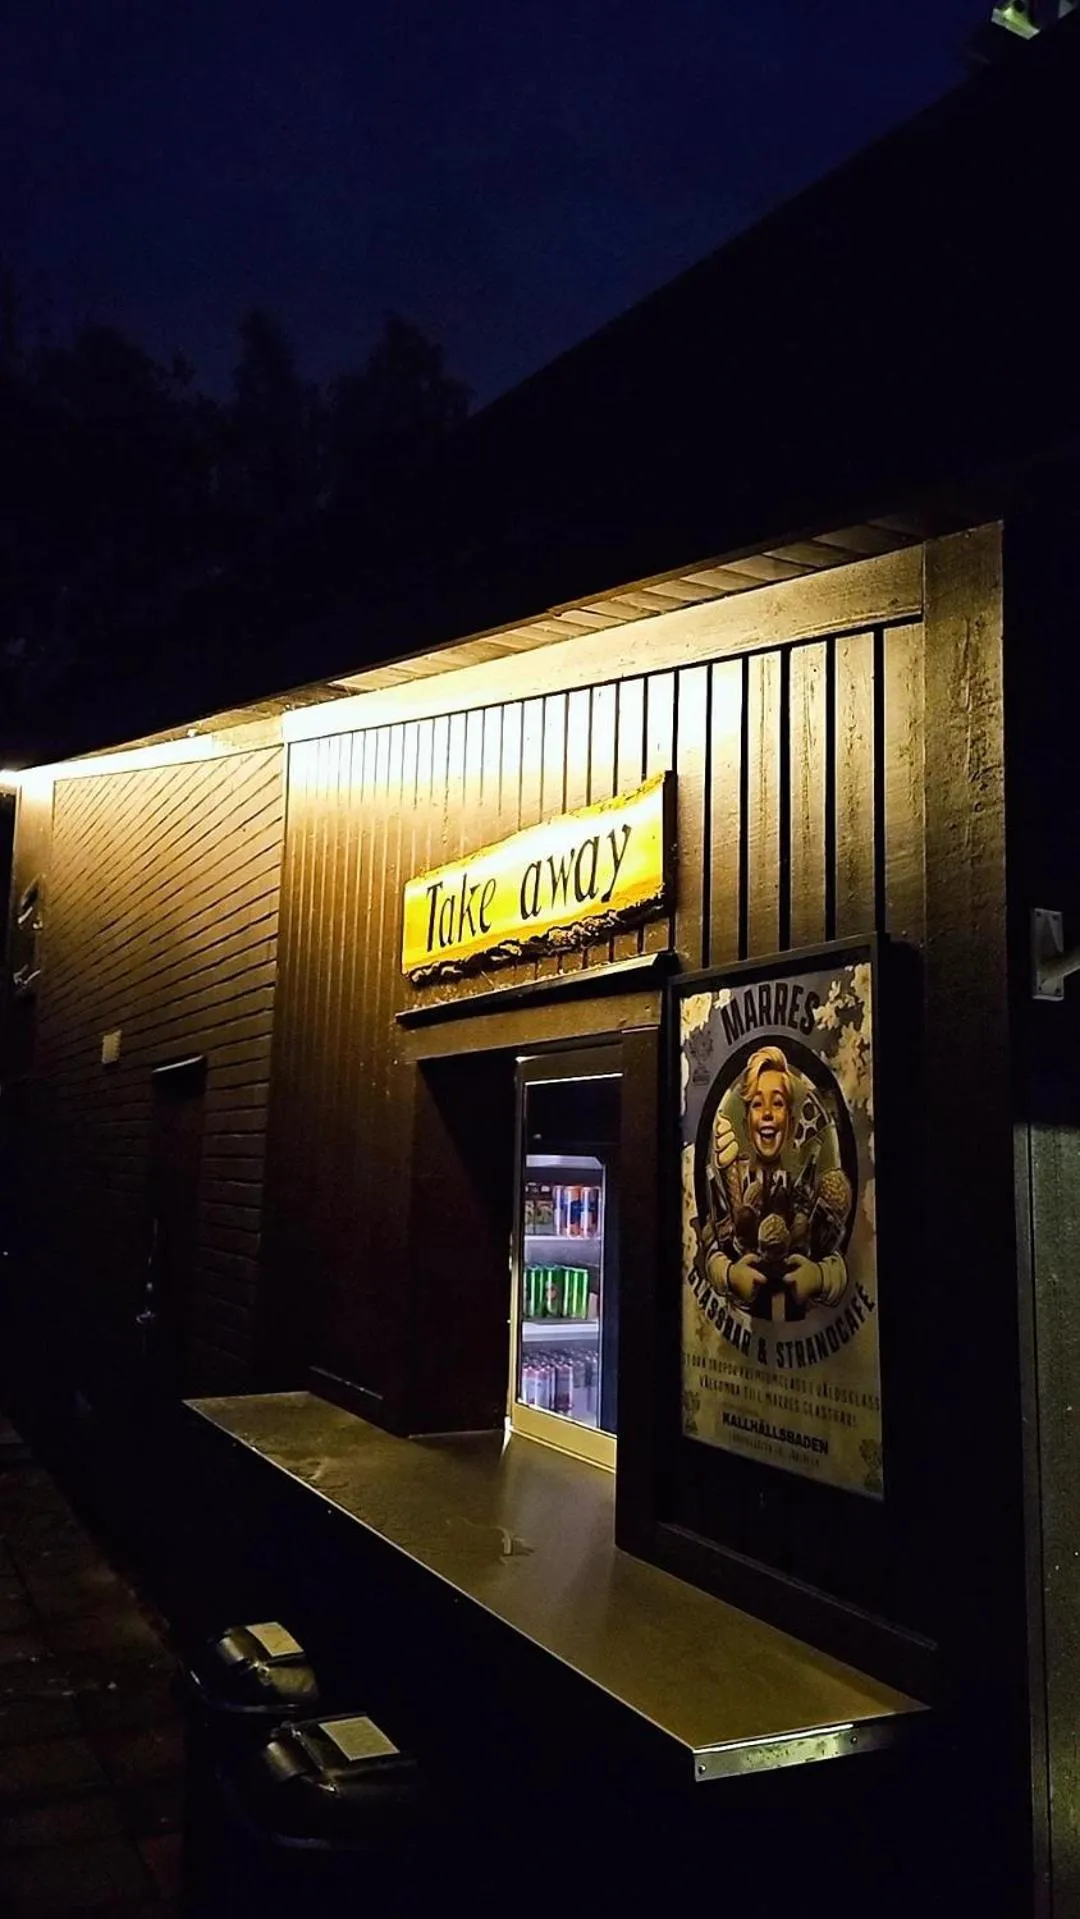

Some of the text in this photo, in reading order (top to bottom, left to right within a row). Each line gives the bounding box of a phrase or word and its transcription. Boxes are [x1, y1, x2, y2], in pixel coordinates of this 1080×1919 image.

[426, 823, 632, 952] Take away
[720, 982, 820, 1046] MARRES
[687, 1266, 752, 1357] GLASSBAR
[758, 1337, 768, 1366] &
